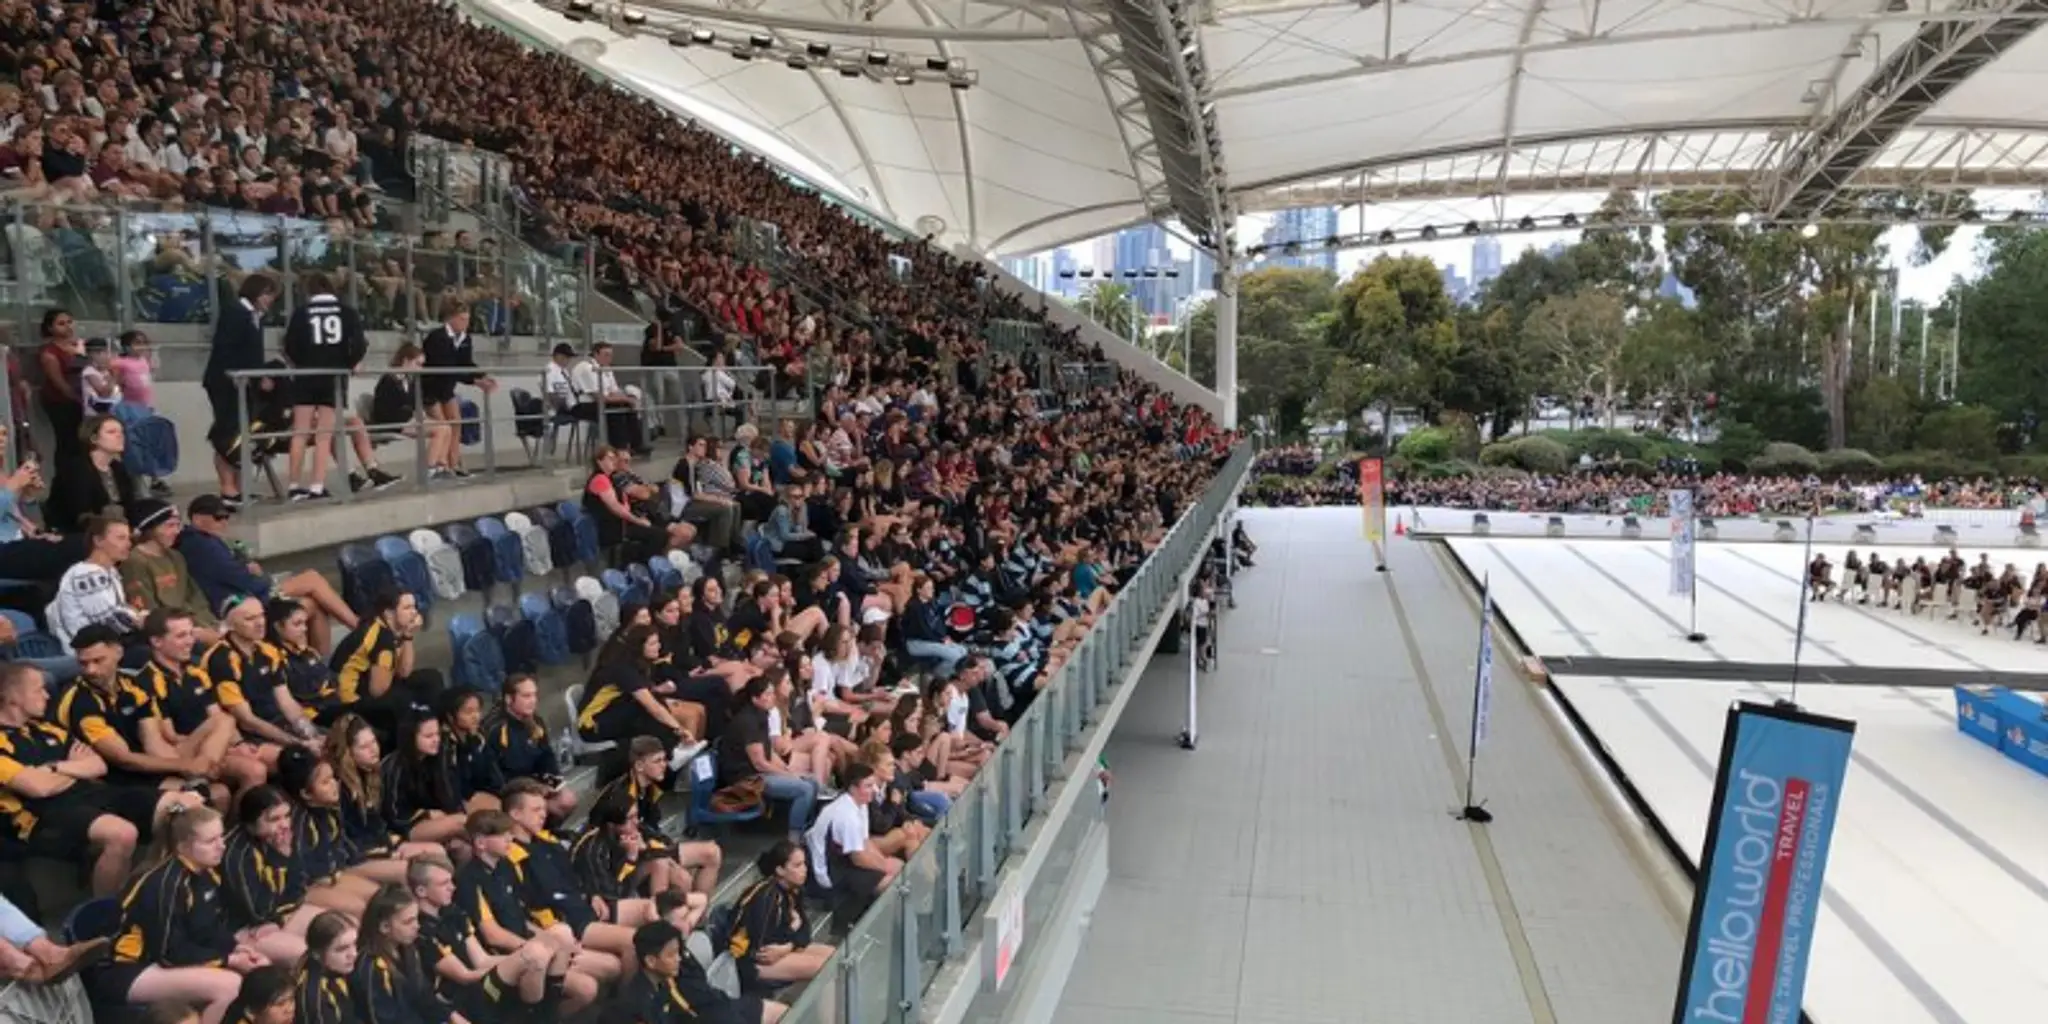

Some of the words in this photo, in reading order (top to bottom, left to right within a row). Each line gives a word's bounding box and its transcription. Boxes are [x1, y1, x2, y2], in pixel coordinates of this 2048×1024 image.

[310, 315, 342, 344] 19
[1694, 767, 1781, 1023] helloworld
[1776, 932, 1799, 998] TRAVEL
[1788, 783, 1828, 927] PROFESSIONALS
[1777, 790, 1804, 861] TRAVEL
